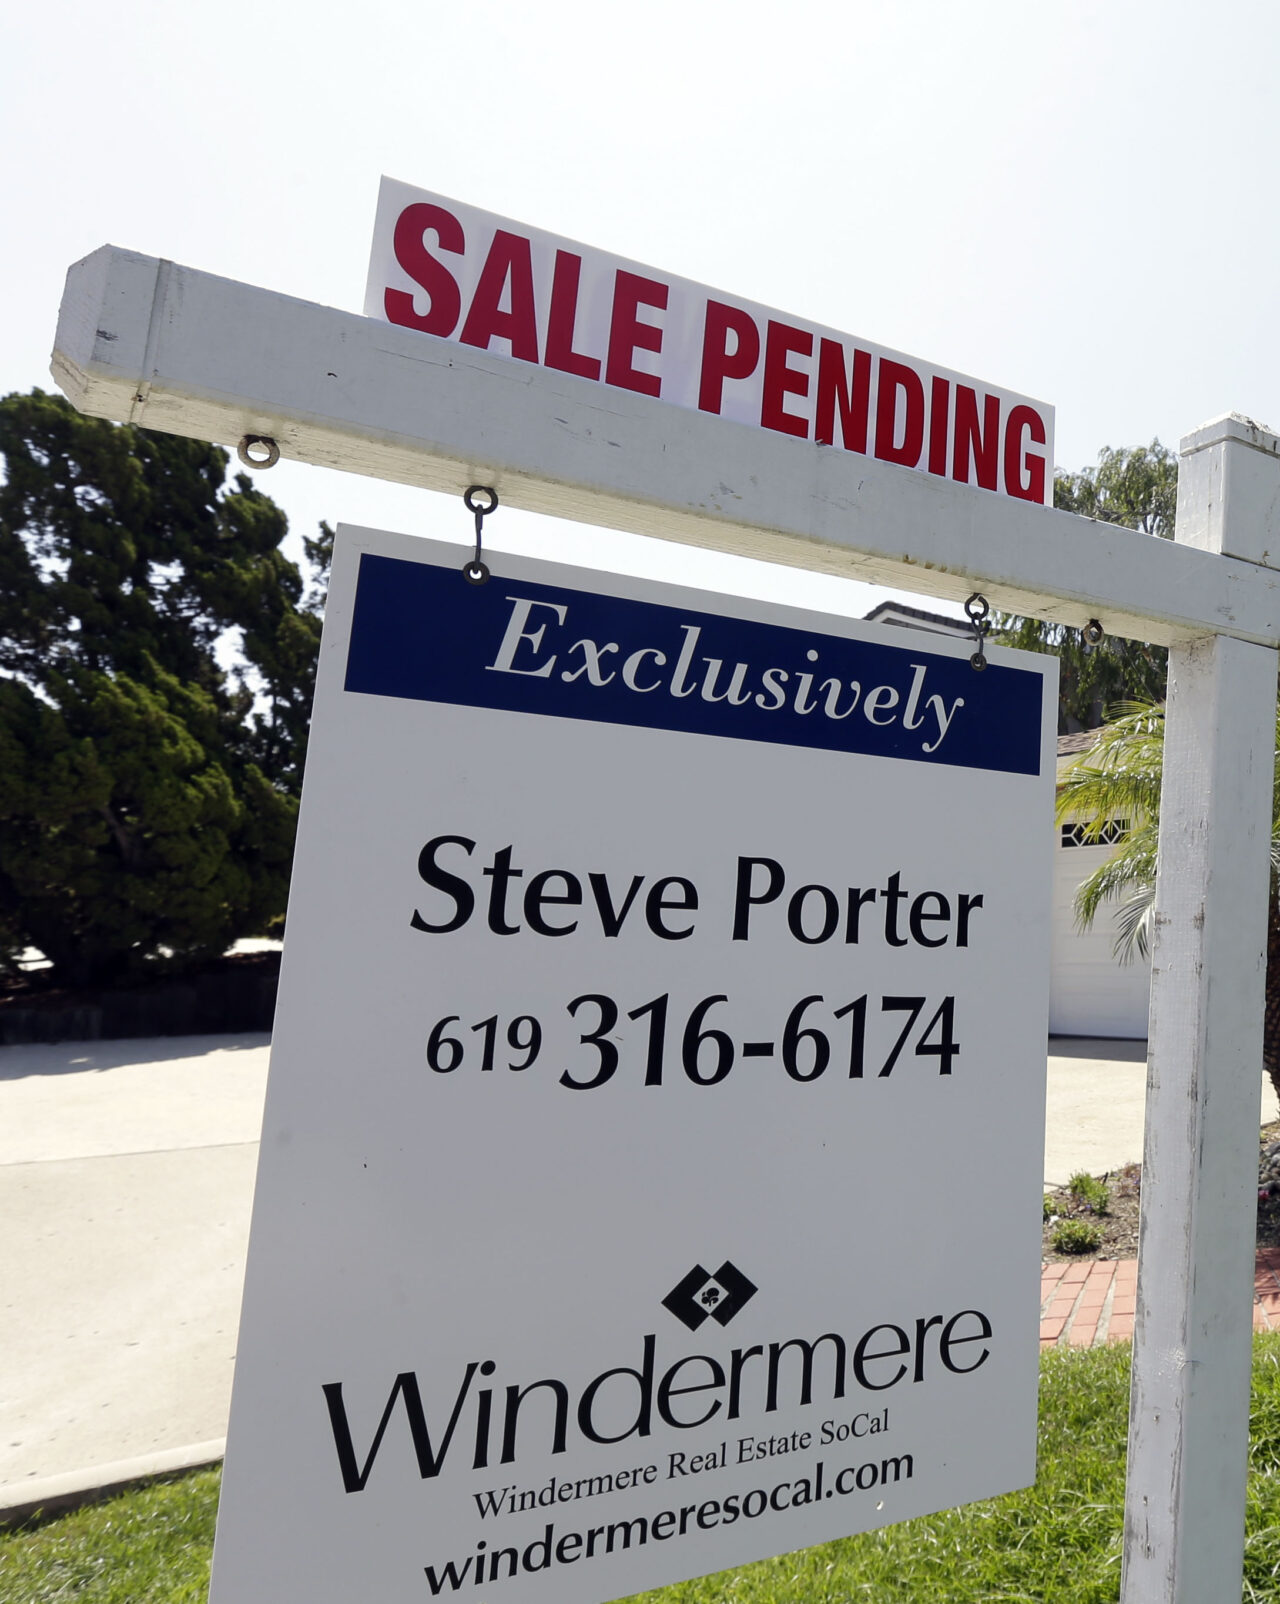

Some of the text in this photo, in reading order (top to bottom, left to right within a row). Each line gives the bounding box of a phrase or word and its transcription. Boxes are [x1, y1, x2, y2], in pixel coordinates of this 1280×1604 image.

[384, 202, 1047, 505] SALE PENDING
[485, 596, 965, 753] Exclusively
[410, 835, 984, 948] Steve Porter
[426, 992, 961, 1091] 619 316-6174
[322, 1309, 993, 1494] Windermere
[472, 1408, 890, 1520] Windermere Real Estate SoCal
[423, 1452, 914, 1596] windermeresocal.com
